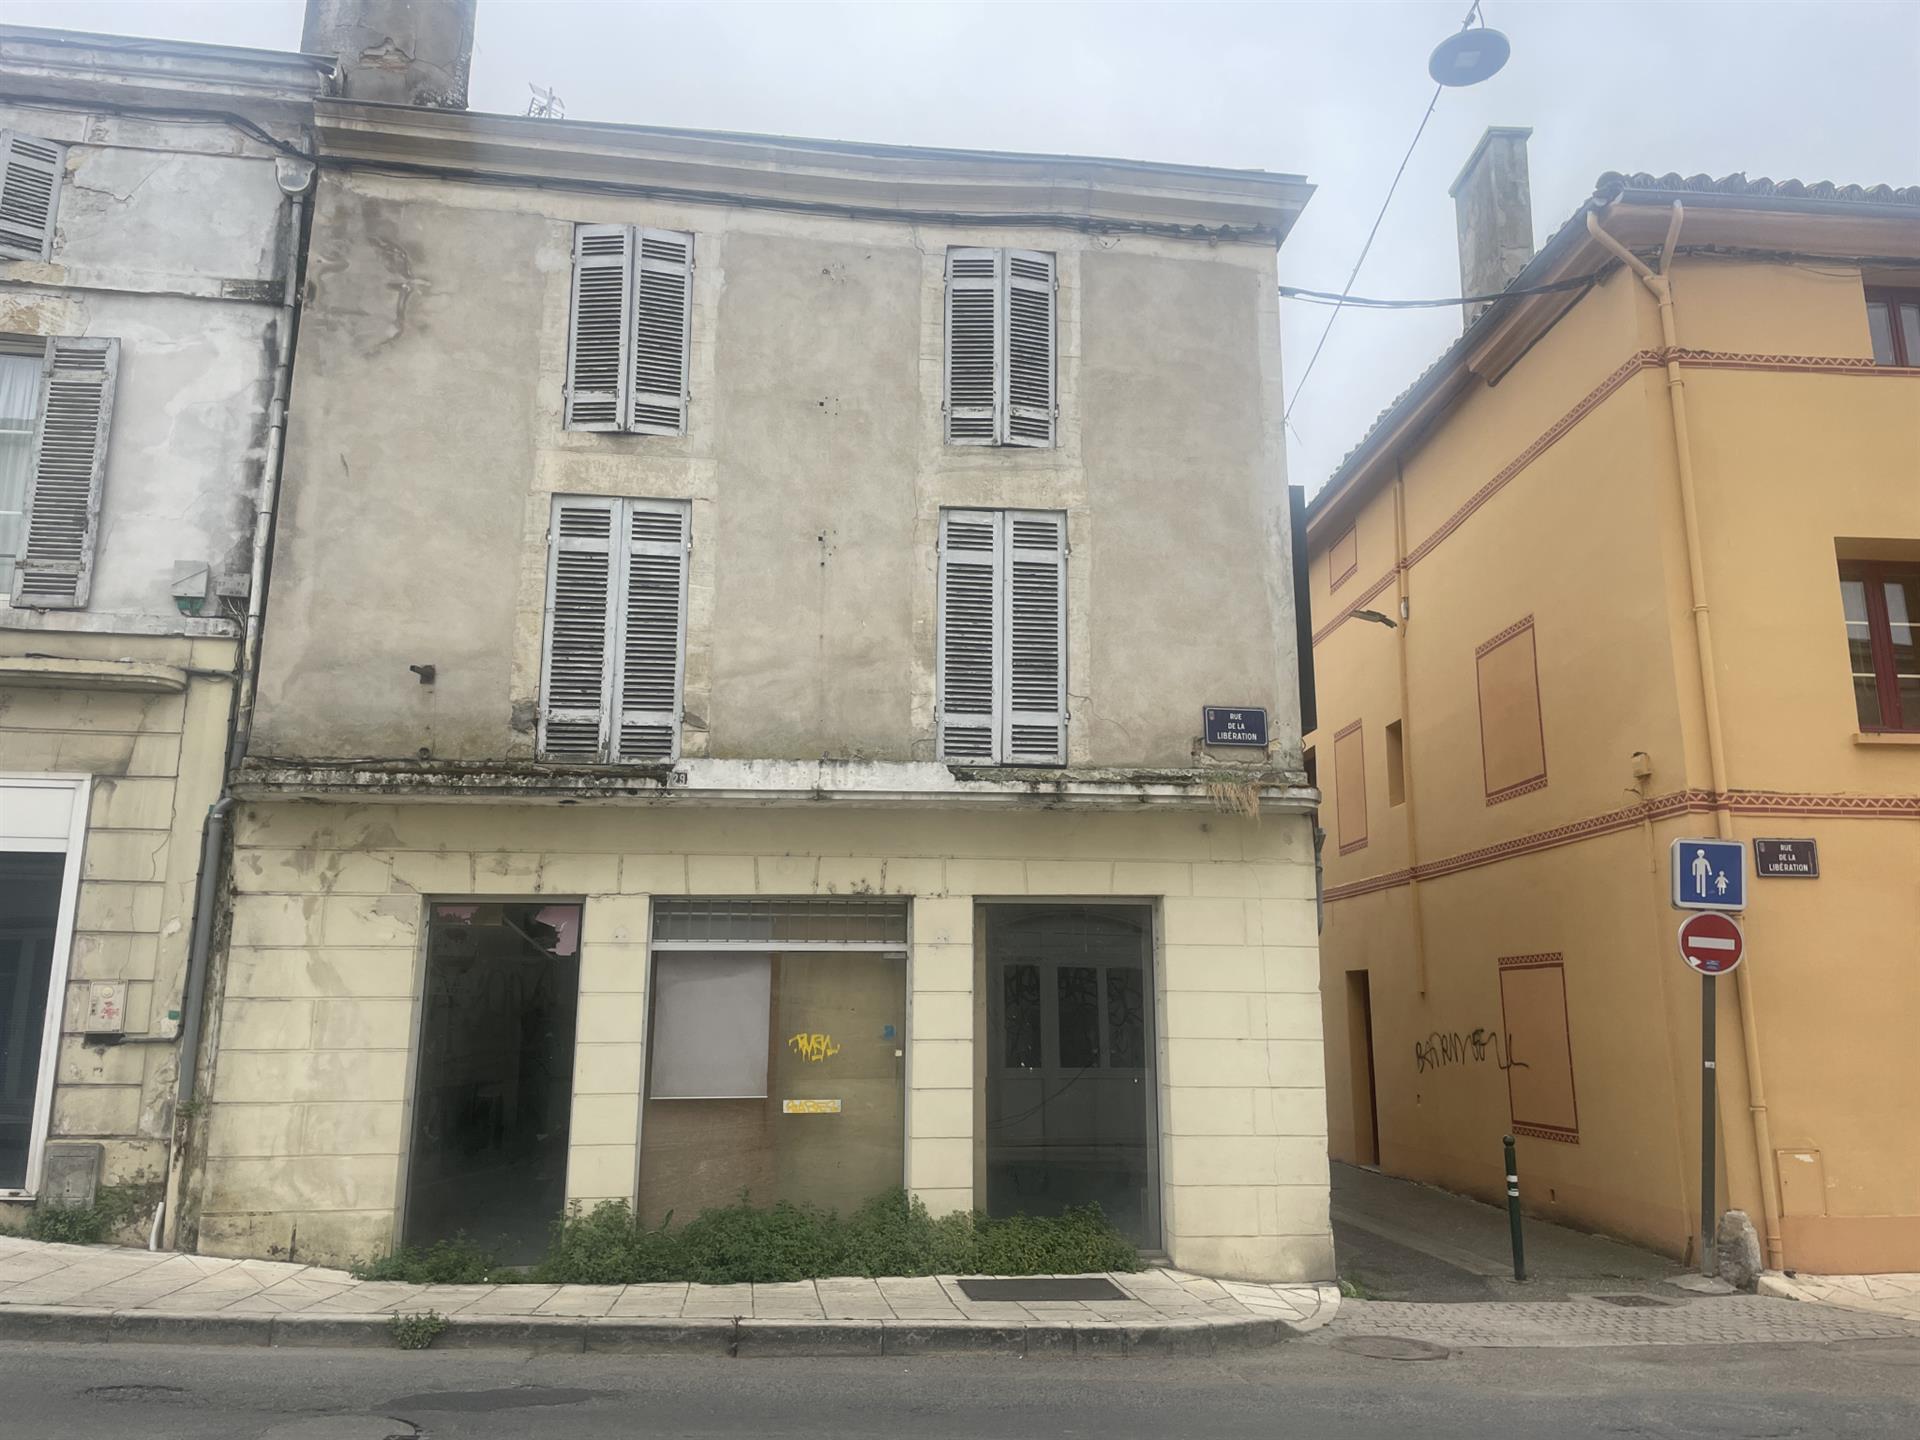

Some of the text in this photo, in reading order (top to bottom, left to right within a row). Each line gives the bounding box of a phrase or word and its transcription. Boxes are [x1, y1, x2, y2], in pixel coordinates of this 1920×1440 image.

[1227, 722, 1236, 730] DE
[1217, 730, 1257, 741] LIBÉRATION
[1778, 853, 1787, 861] DE
[1768, 862, 1809, 872] LIBÉRATION
